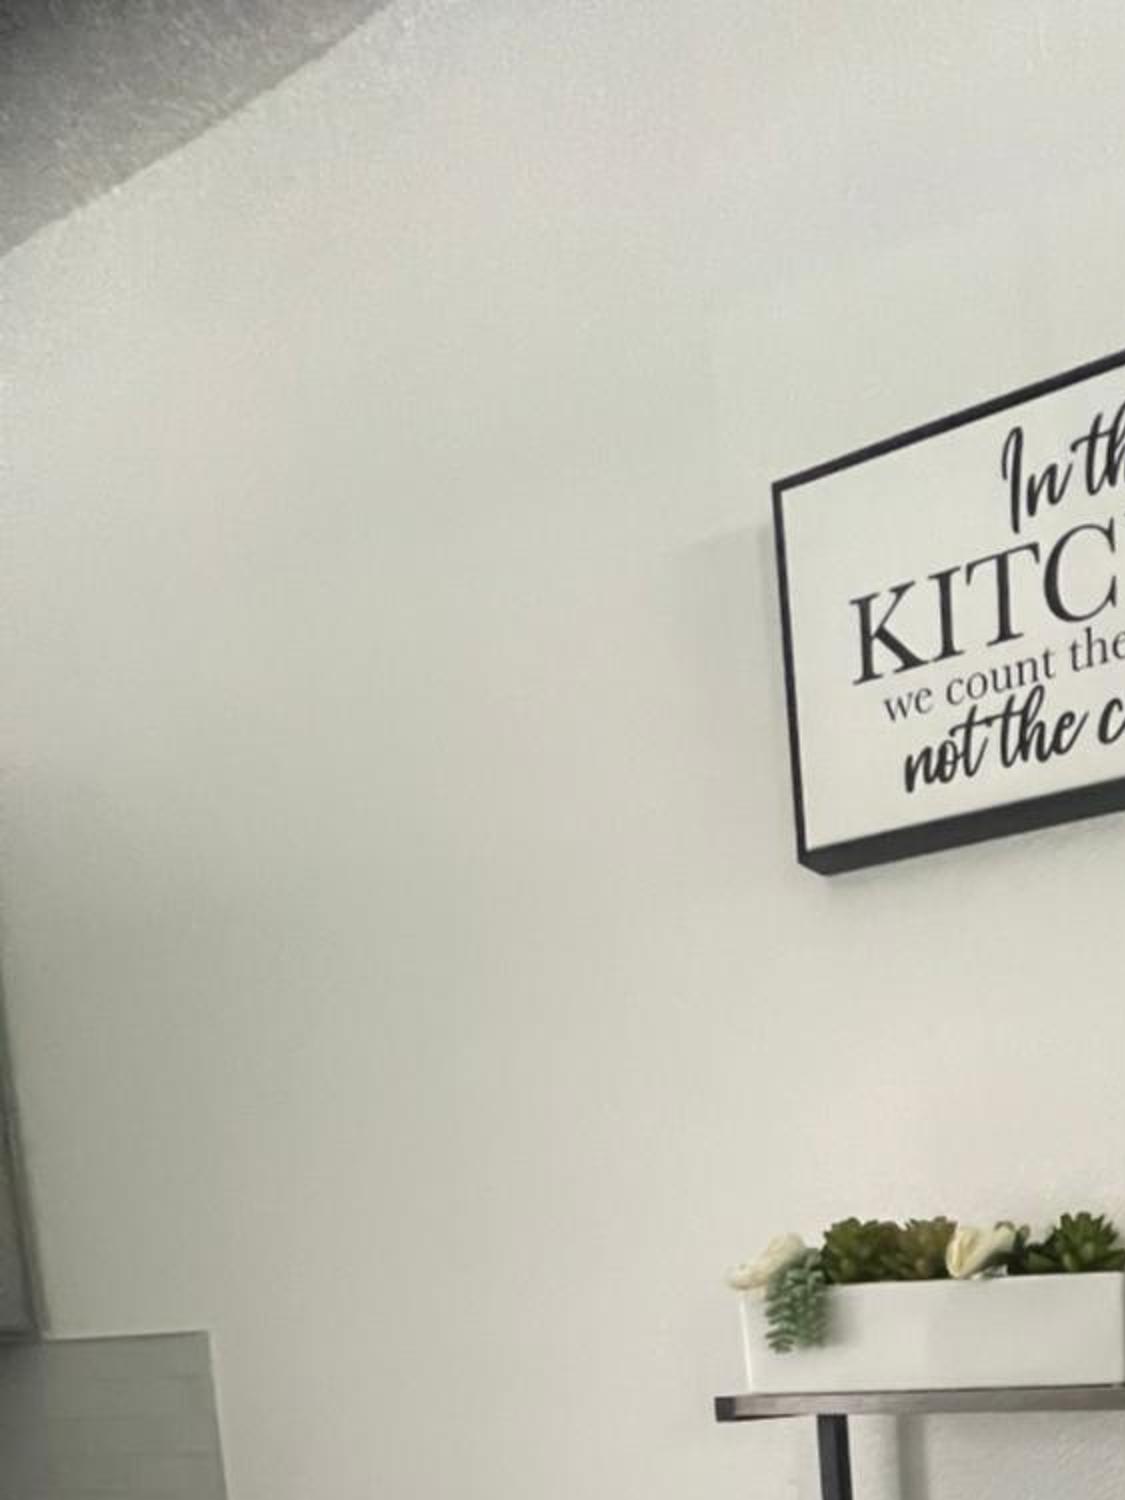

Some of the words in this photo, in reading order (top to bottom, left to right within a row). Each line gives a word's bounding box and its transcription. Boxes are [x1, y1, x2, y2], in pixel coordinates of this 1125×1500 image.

[1001, 425, 1074, 534] In
[883, 683, 934, 723] we
[945, 648, 1056, 708] count
[904, 713, 997, 793] not
[999, 685, 1090, 769] the
